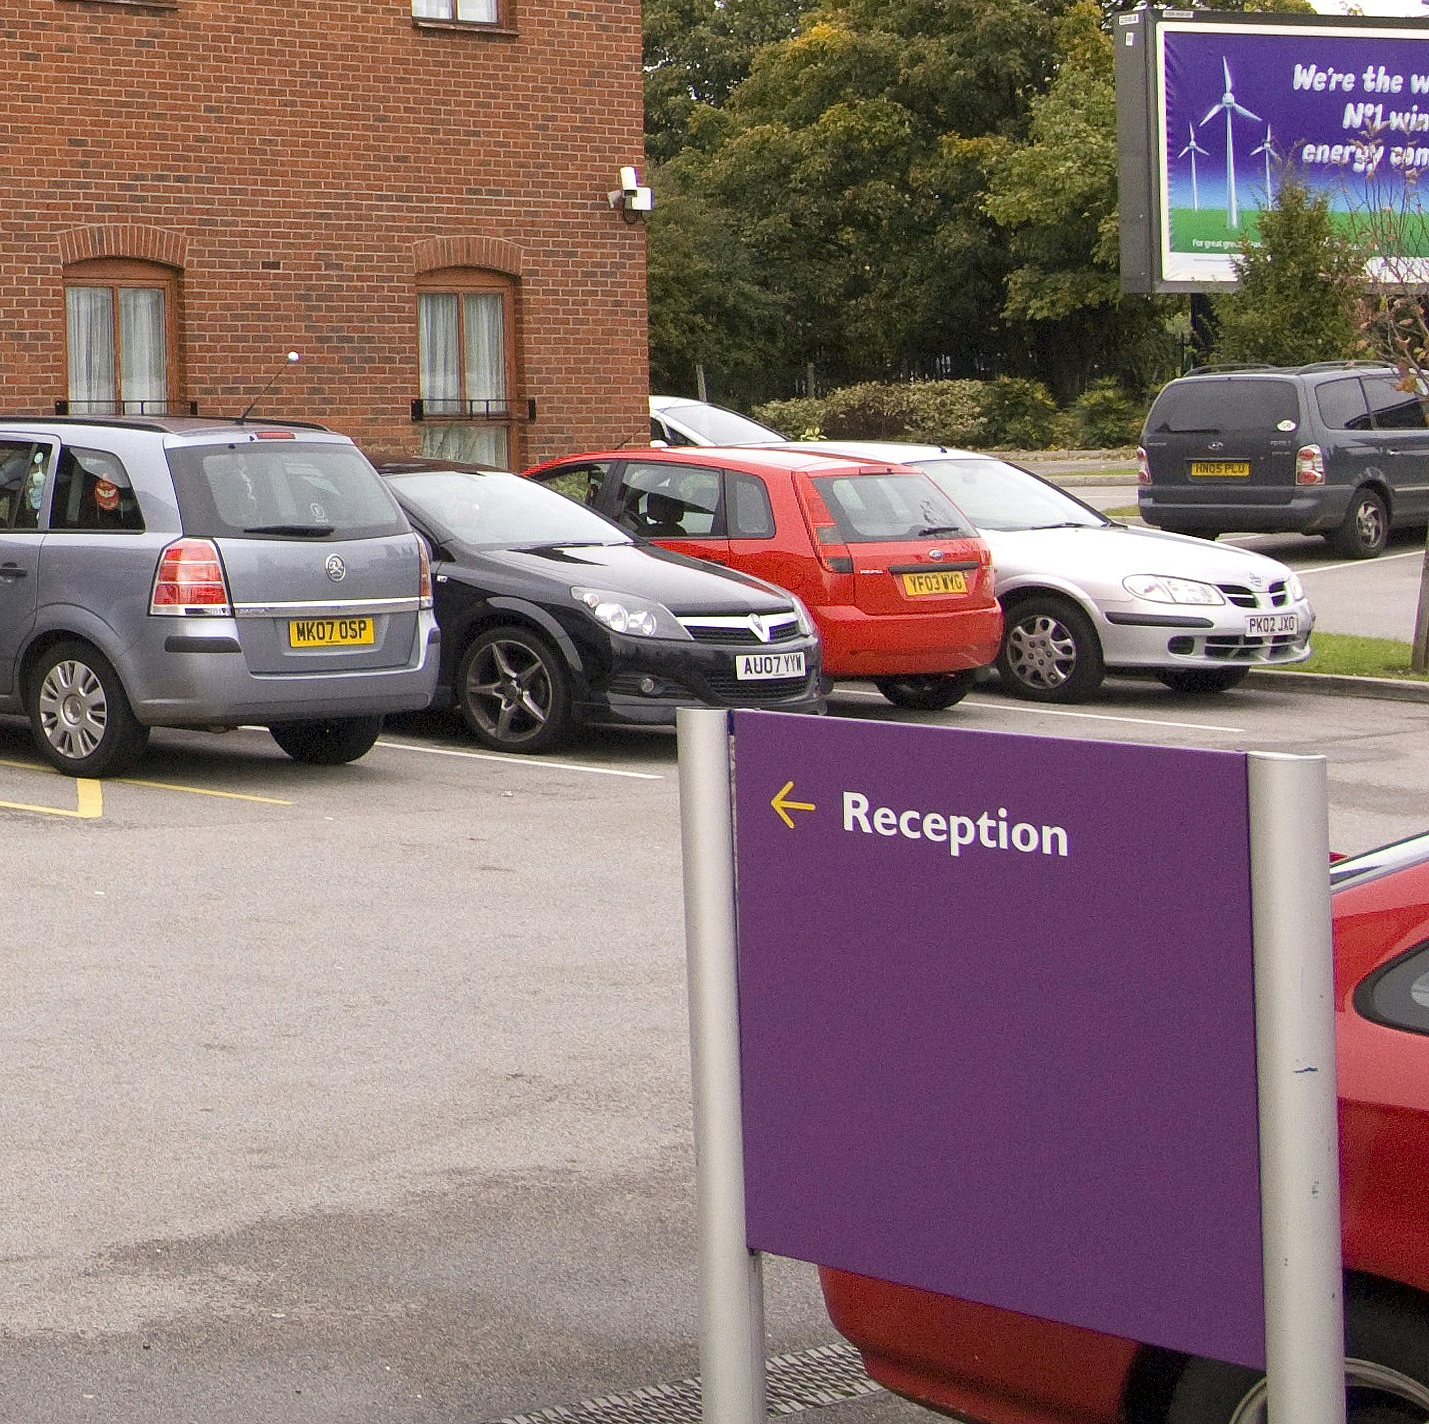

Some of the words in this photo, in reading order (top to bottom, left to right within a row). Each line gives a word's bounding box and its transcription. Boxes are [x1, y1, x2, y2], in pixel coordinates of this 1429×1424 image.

[1292, 63, 1356, 92] We're
[1362, 65, 1404, 94] the
[1301, 144, 1385, 173] energy
[908, 574, 940, 593] YF03
[296, 620, 335, 642] MK07
[339, 619, 367, 640] OSP
[1249, 617, 1276, 633] PK02
[744, 656, 781, 675] AU07
[842, 790, 1069, 857] Reception
